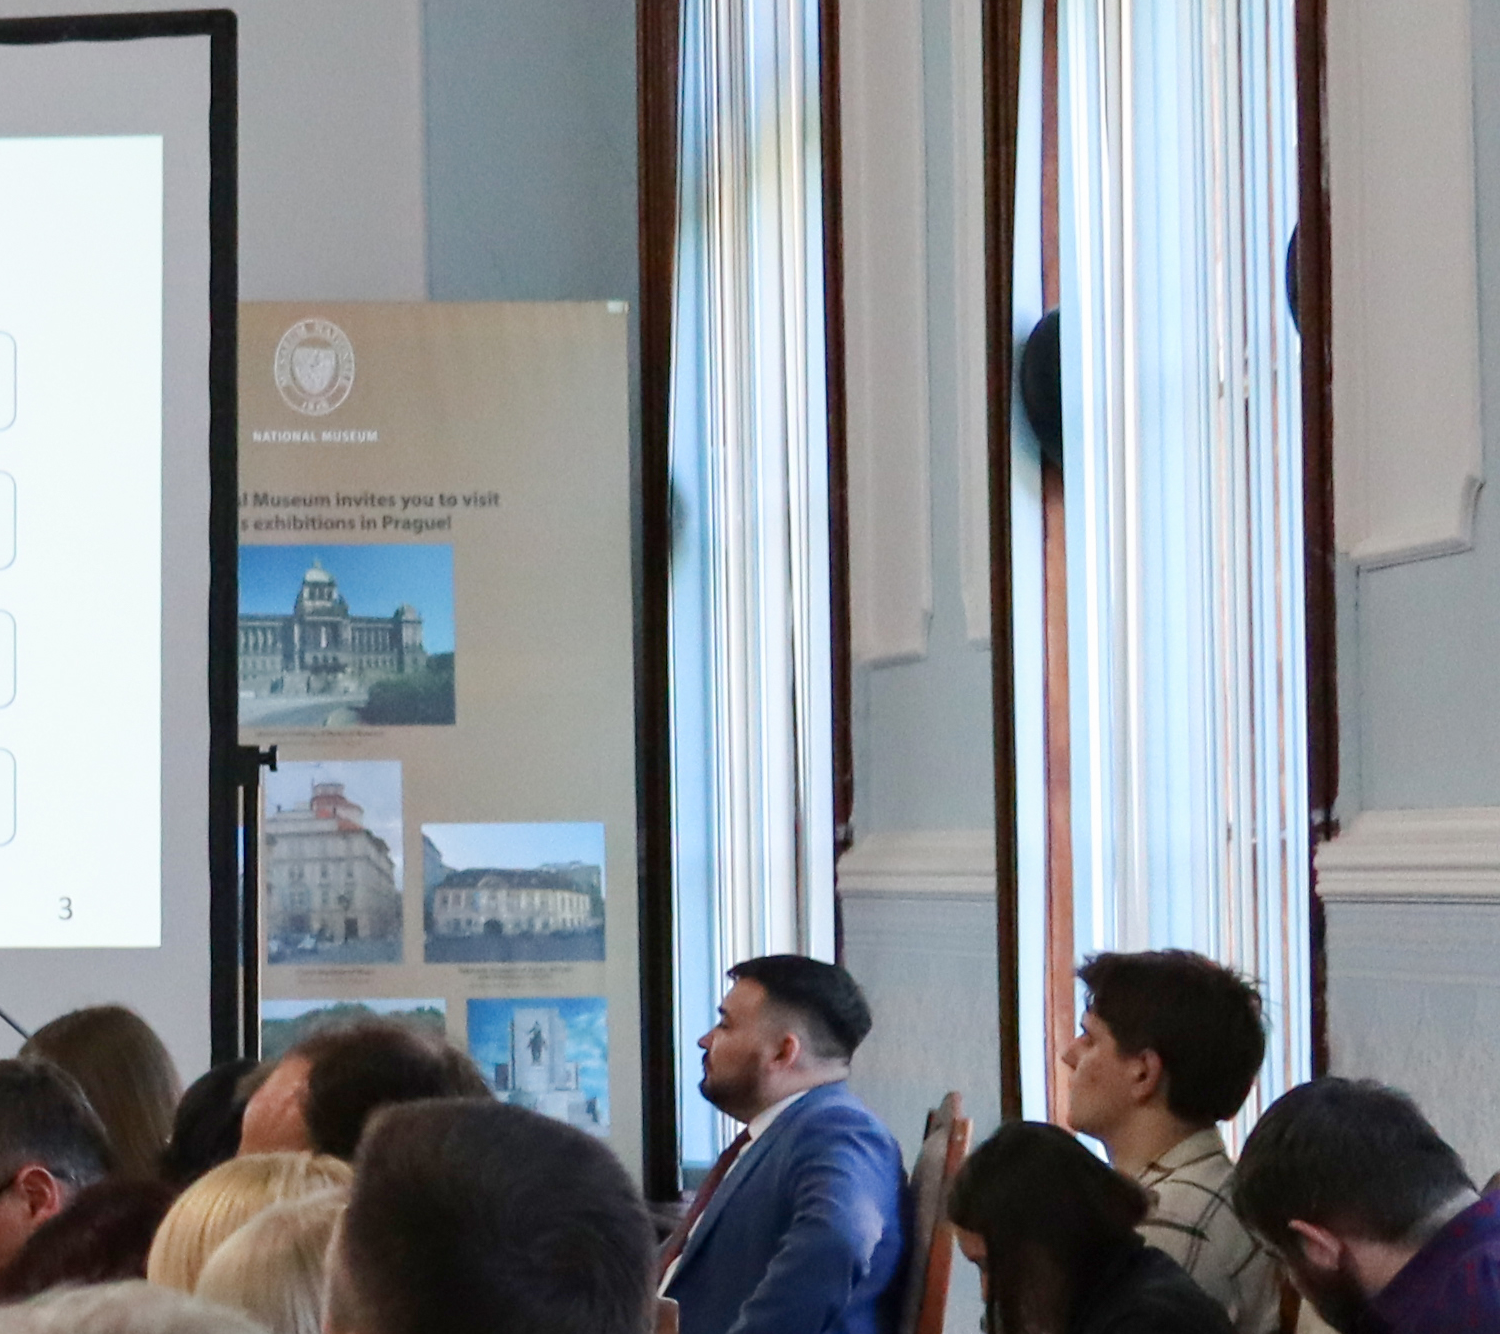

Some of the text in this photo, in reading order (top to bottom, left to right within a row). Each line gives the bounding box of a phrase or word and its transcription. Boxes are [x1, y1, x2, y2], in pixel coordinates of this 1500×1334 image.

[253, 431, 379, 443] NATIONAL MUSEUM
[253, 493, 331, 507] Museum
[336, 492, 397, 507] invites
[401, 495, 434, 510] you
[439, 493, 458, 507] to
[462, 492, 500, 507] visit
[253, 515, 355, 531] exhibitions
[360, 516, 377, 530] in
[59, 896, 74, 921] 3
